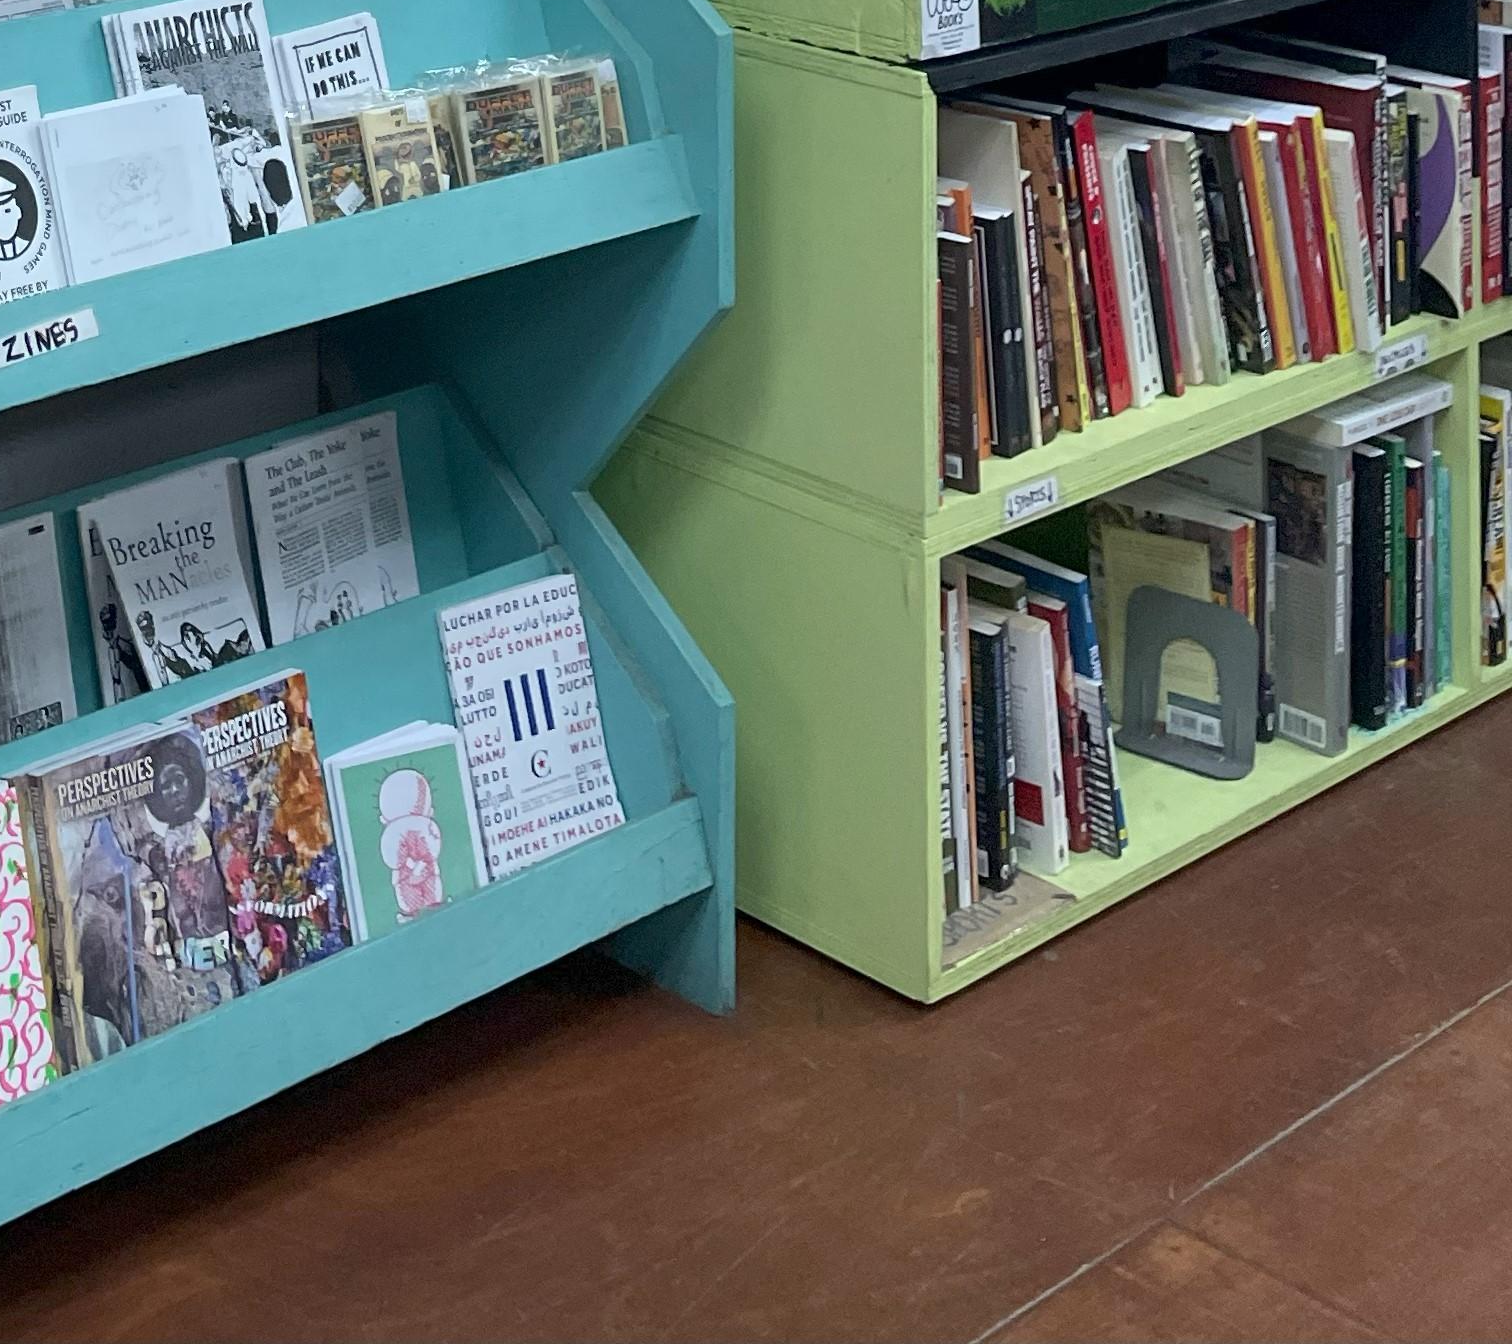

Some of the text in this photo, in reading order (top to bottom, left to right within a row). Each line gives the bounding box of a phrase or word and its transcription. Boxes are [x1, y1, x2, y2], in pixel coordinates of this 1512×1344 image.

[132, 2, 256, 54] ANARCHISTS
[937, 13, 964, 30] BOOKS
[305, 43, 361, 72] IF WE CAN
[2, 318, 78, 363] ZINES
[109, 517, 217, 565] Breaking
[58, 756, 155, 806] PERSPECTIVES
